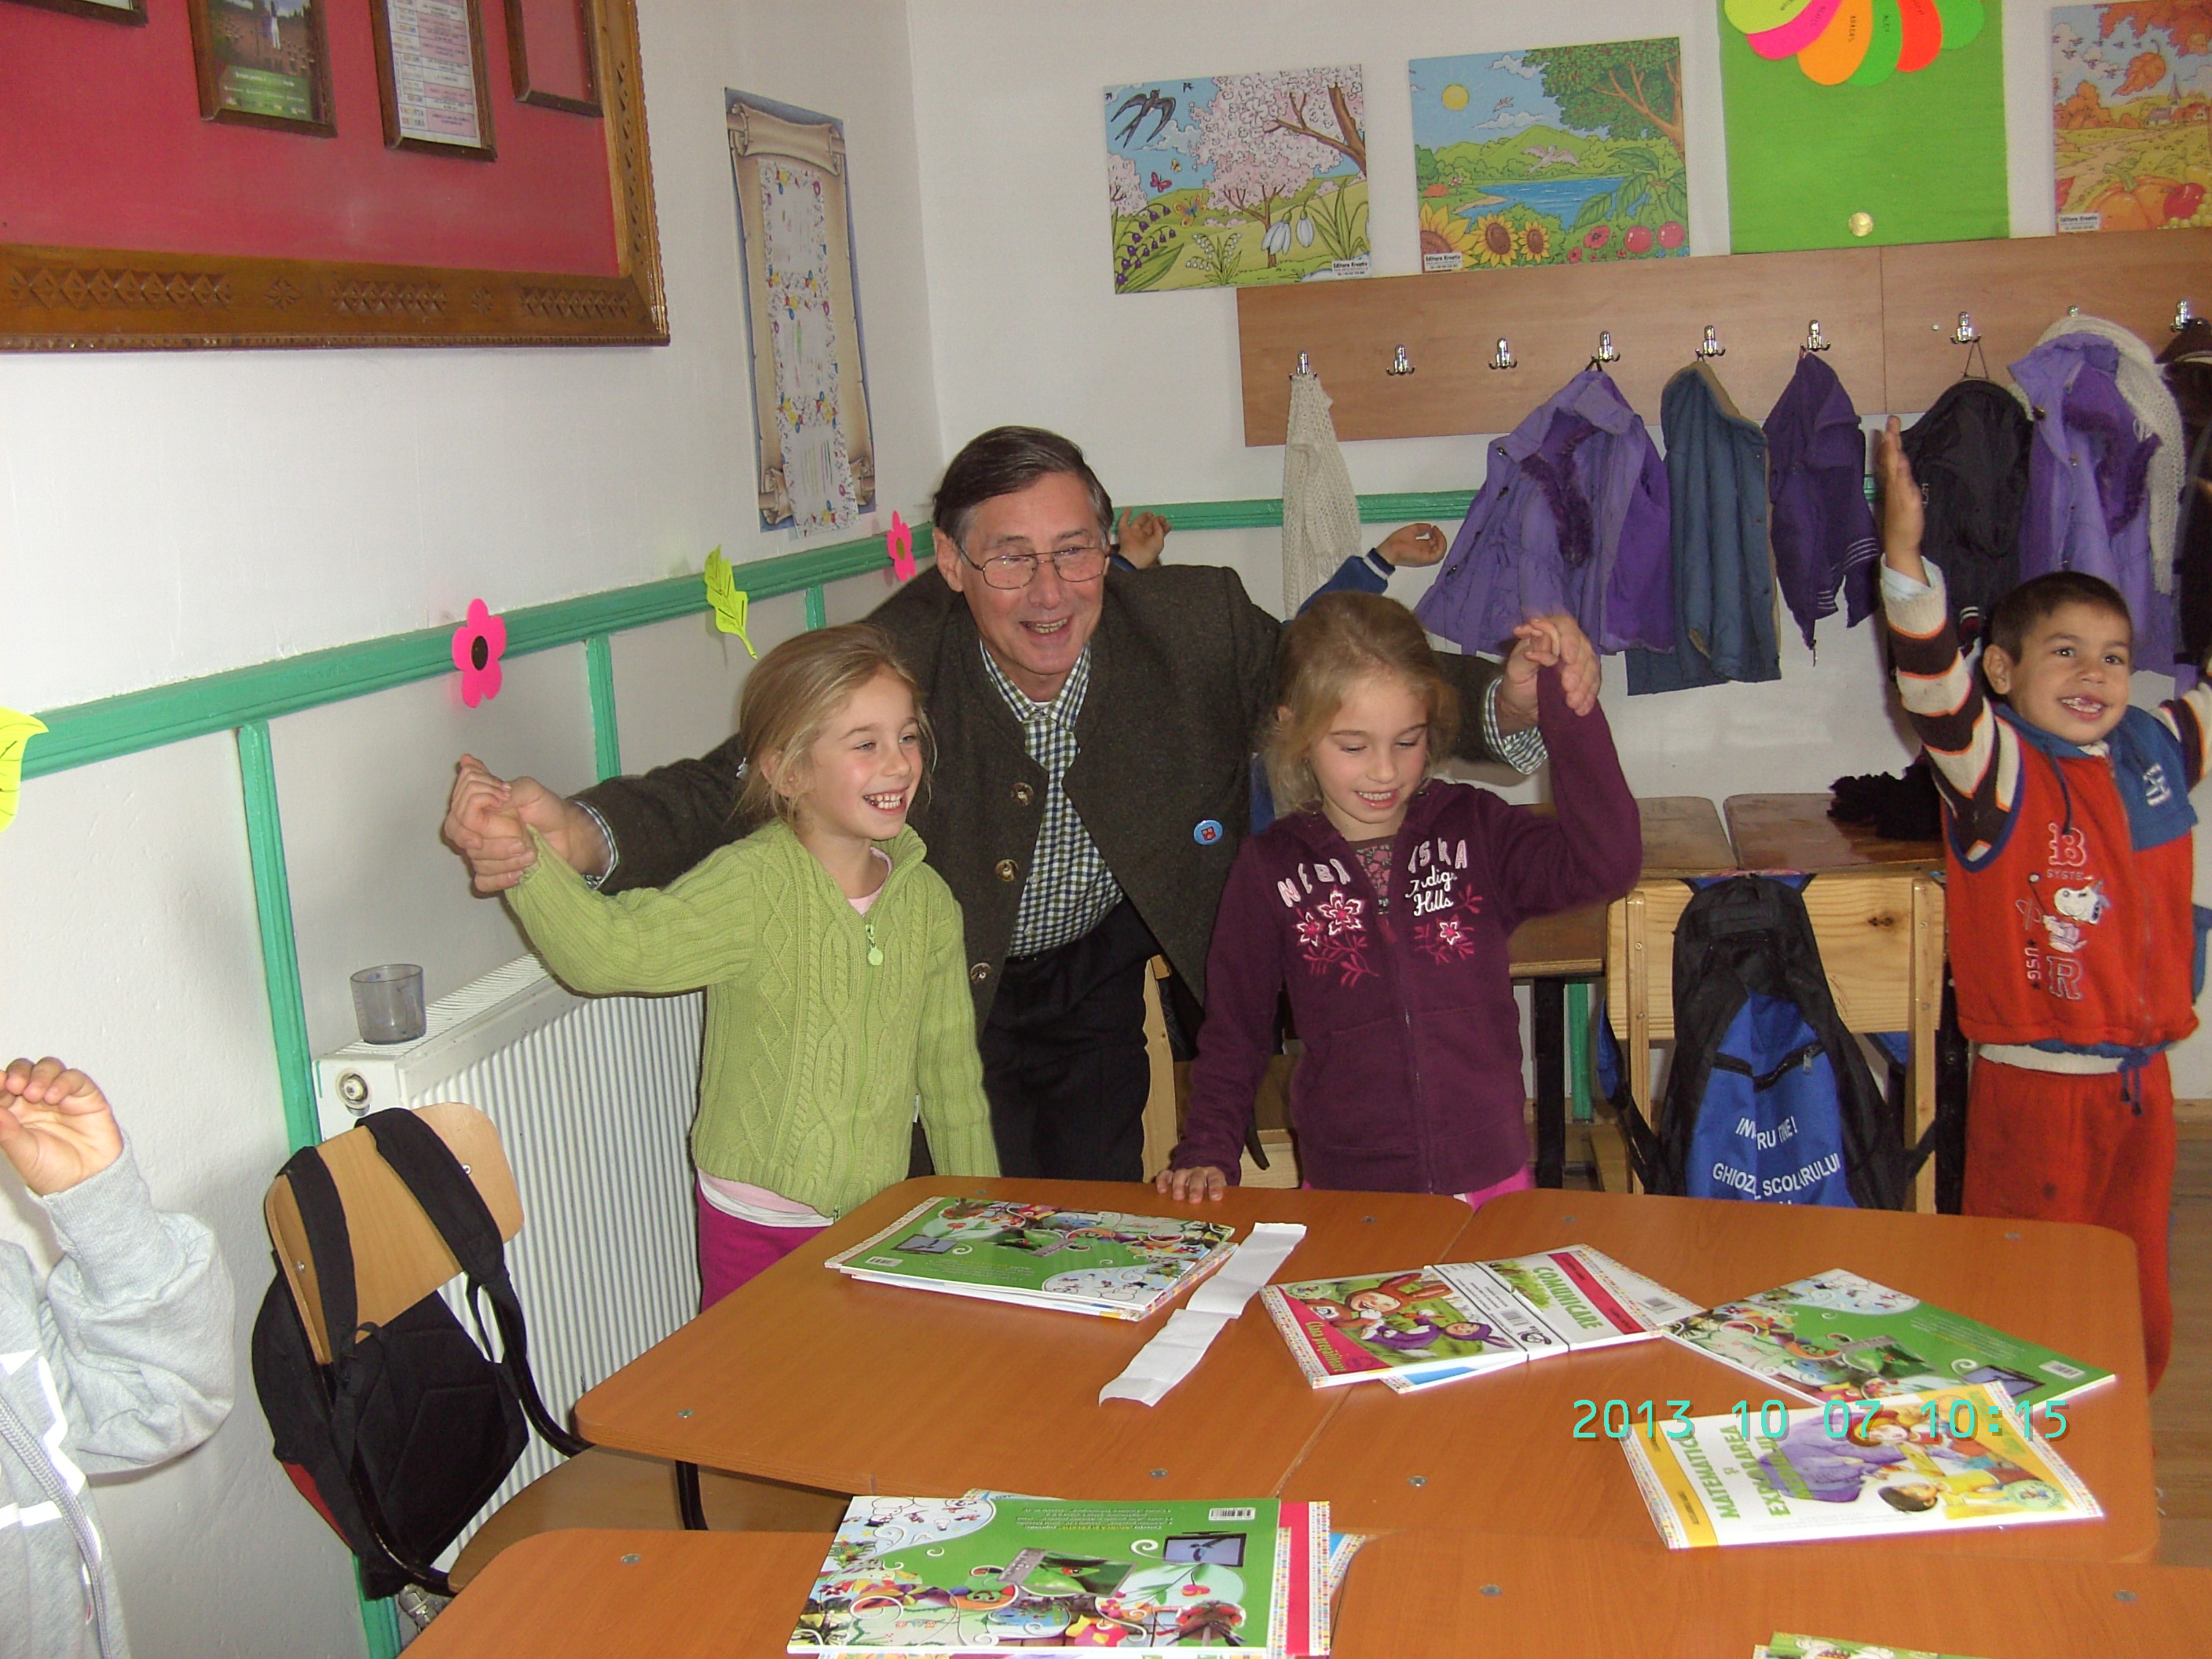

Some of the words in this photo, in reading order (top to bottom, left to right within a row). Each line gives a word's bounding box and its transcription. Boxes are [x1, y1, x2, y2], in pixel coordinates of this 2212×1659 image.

[1412, 890, 1455, 917] Hills
[1533, 1265, 1603, 1330] COMUNICARE
[1305, 1321, 1325, 1339] Clasa
